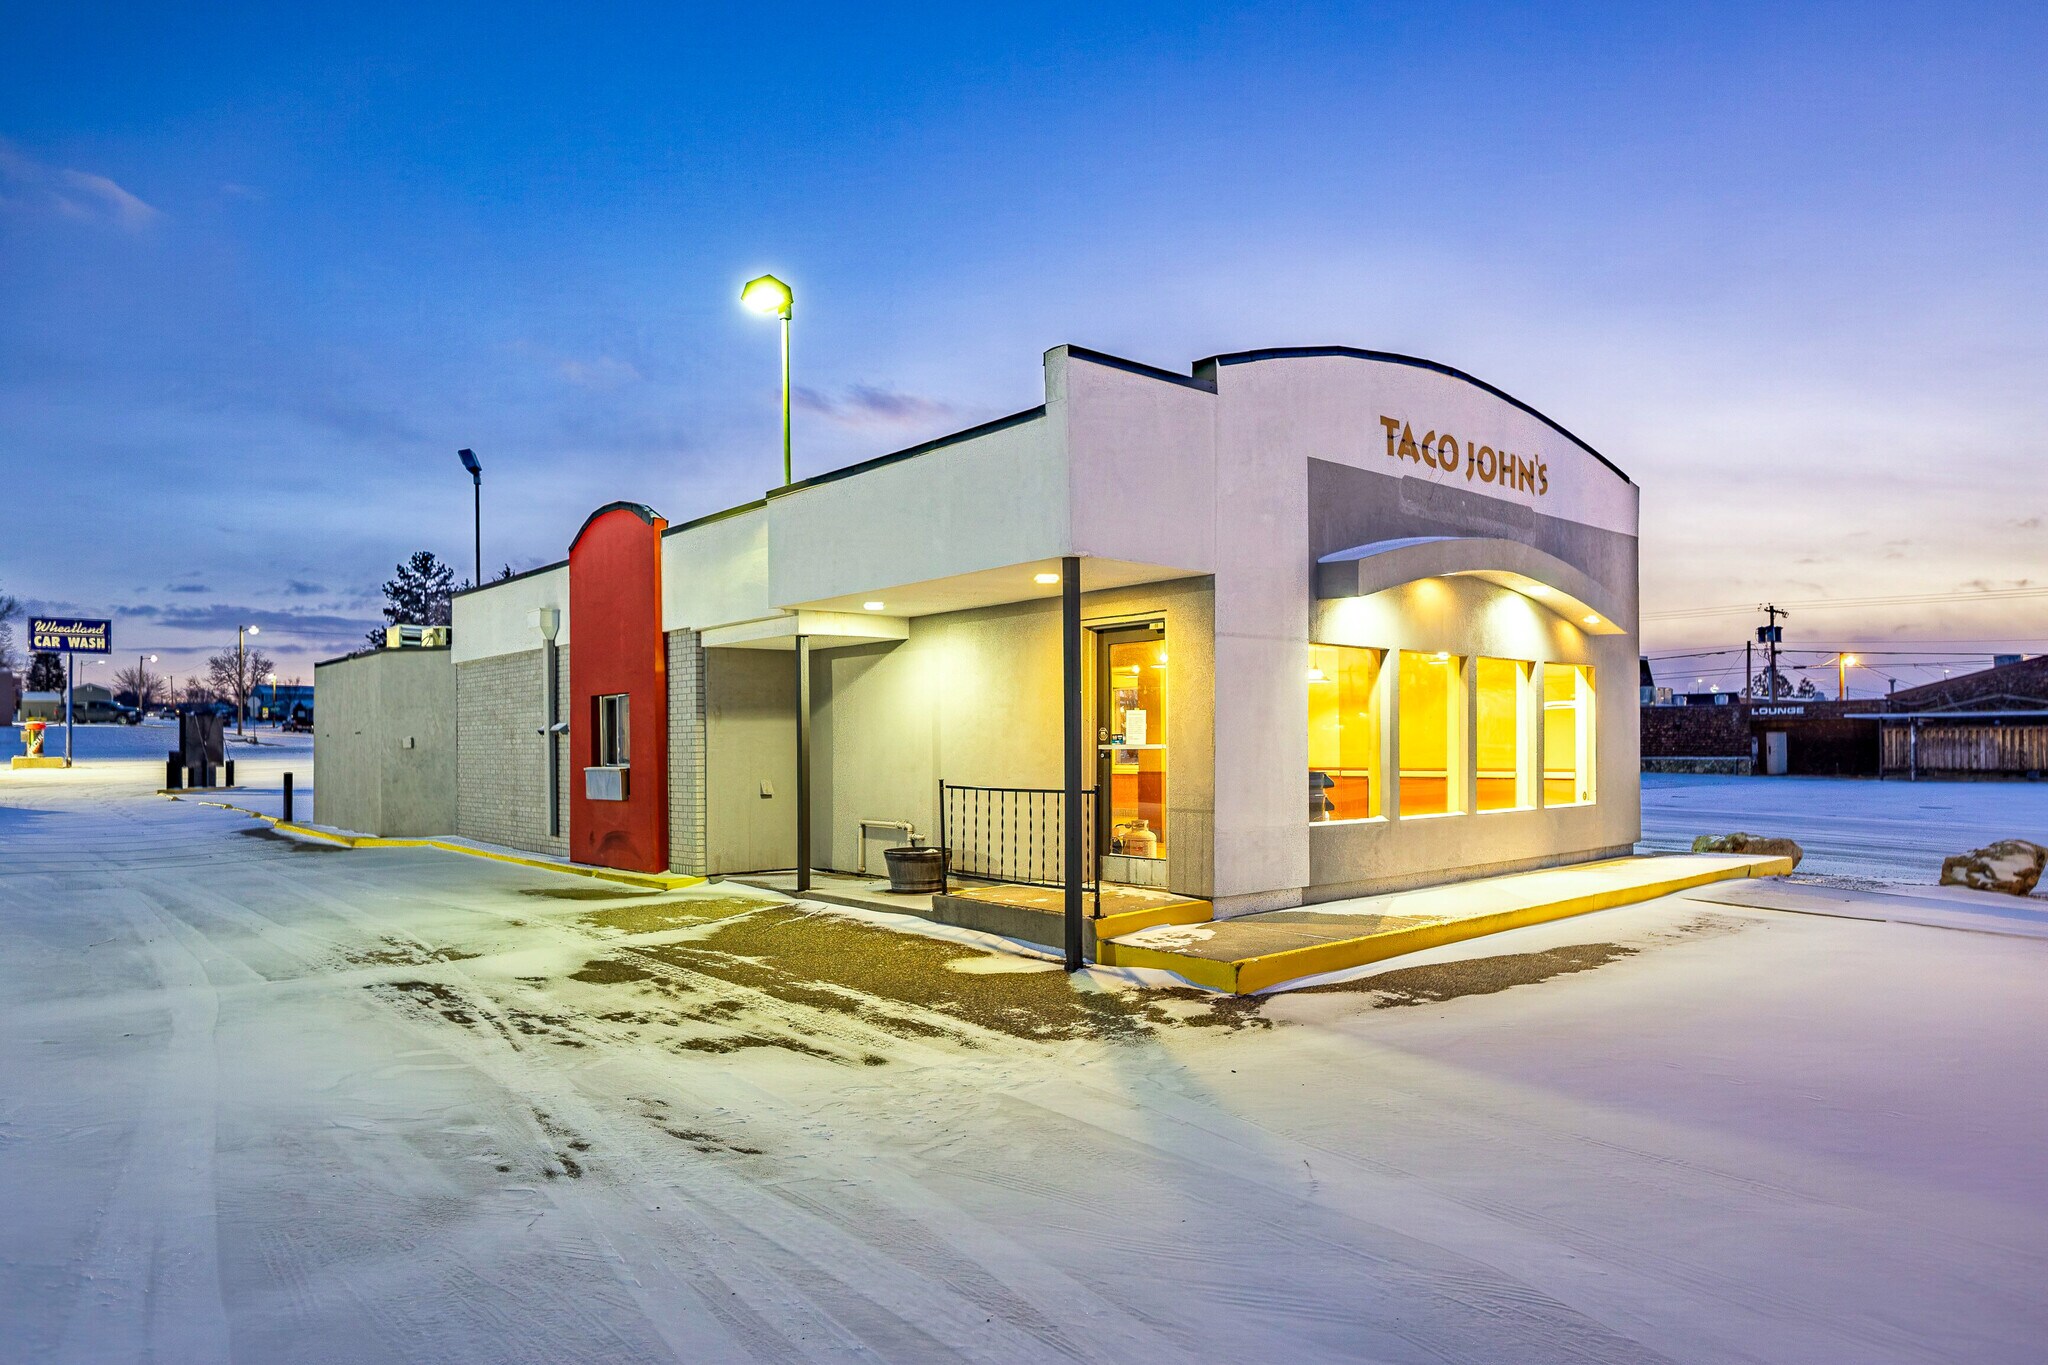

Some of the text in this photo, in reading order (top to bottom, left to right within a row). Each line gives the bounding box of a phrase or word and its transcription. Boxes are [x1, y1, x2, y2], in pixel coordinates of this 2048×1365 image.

[1380, 415, 1548, 496] TACO JOHN'S
[34, 620, 106, 634] Wheatland
[34, 635, 106, 650] CAR WASH
[1751, 706, 1805, 716] LOUNGE
